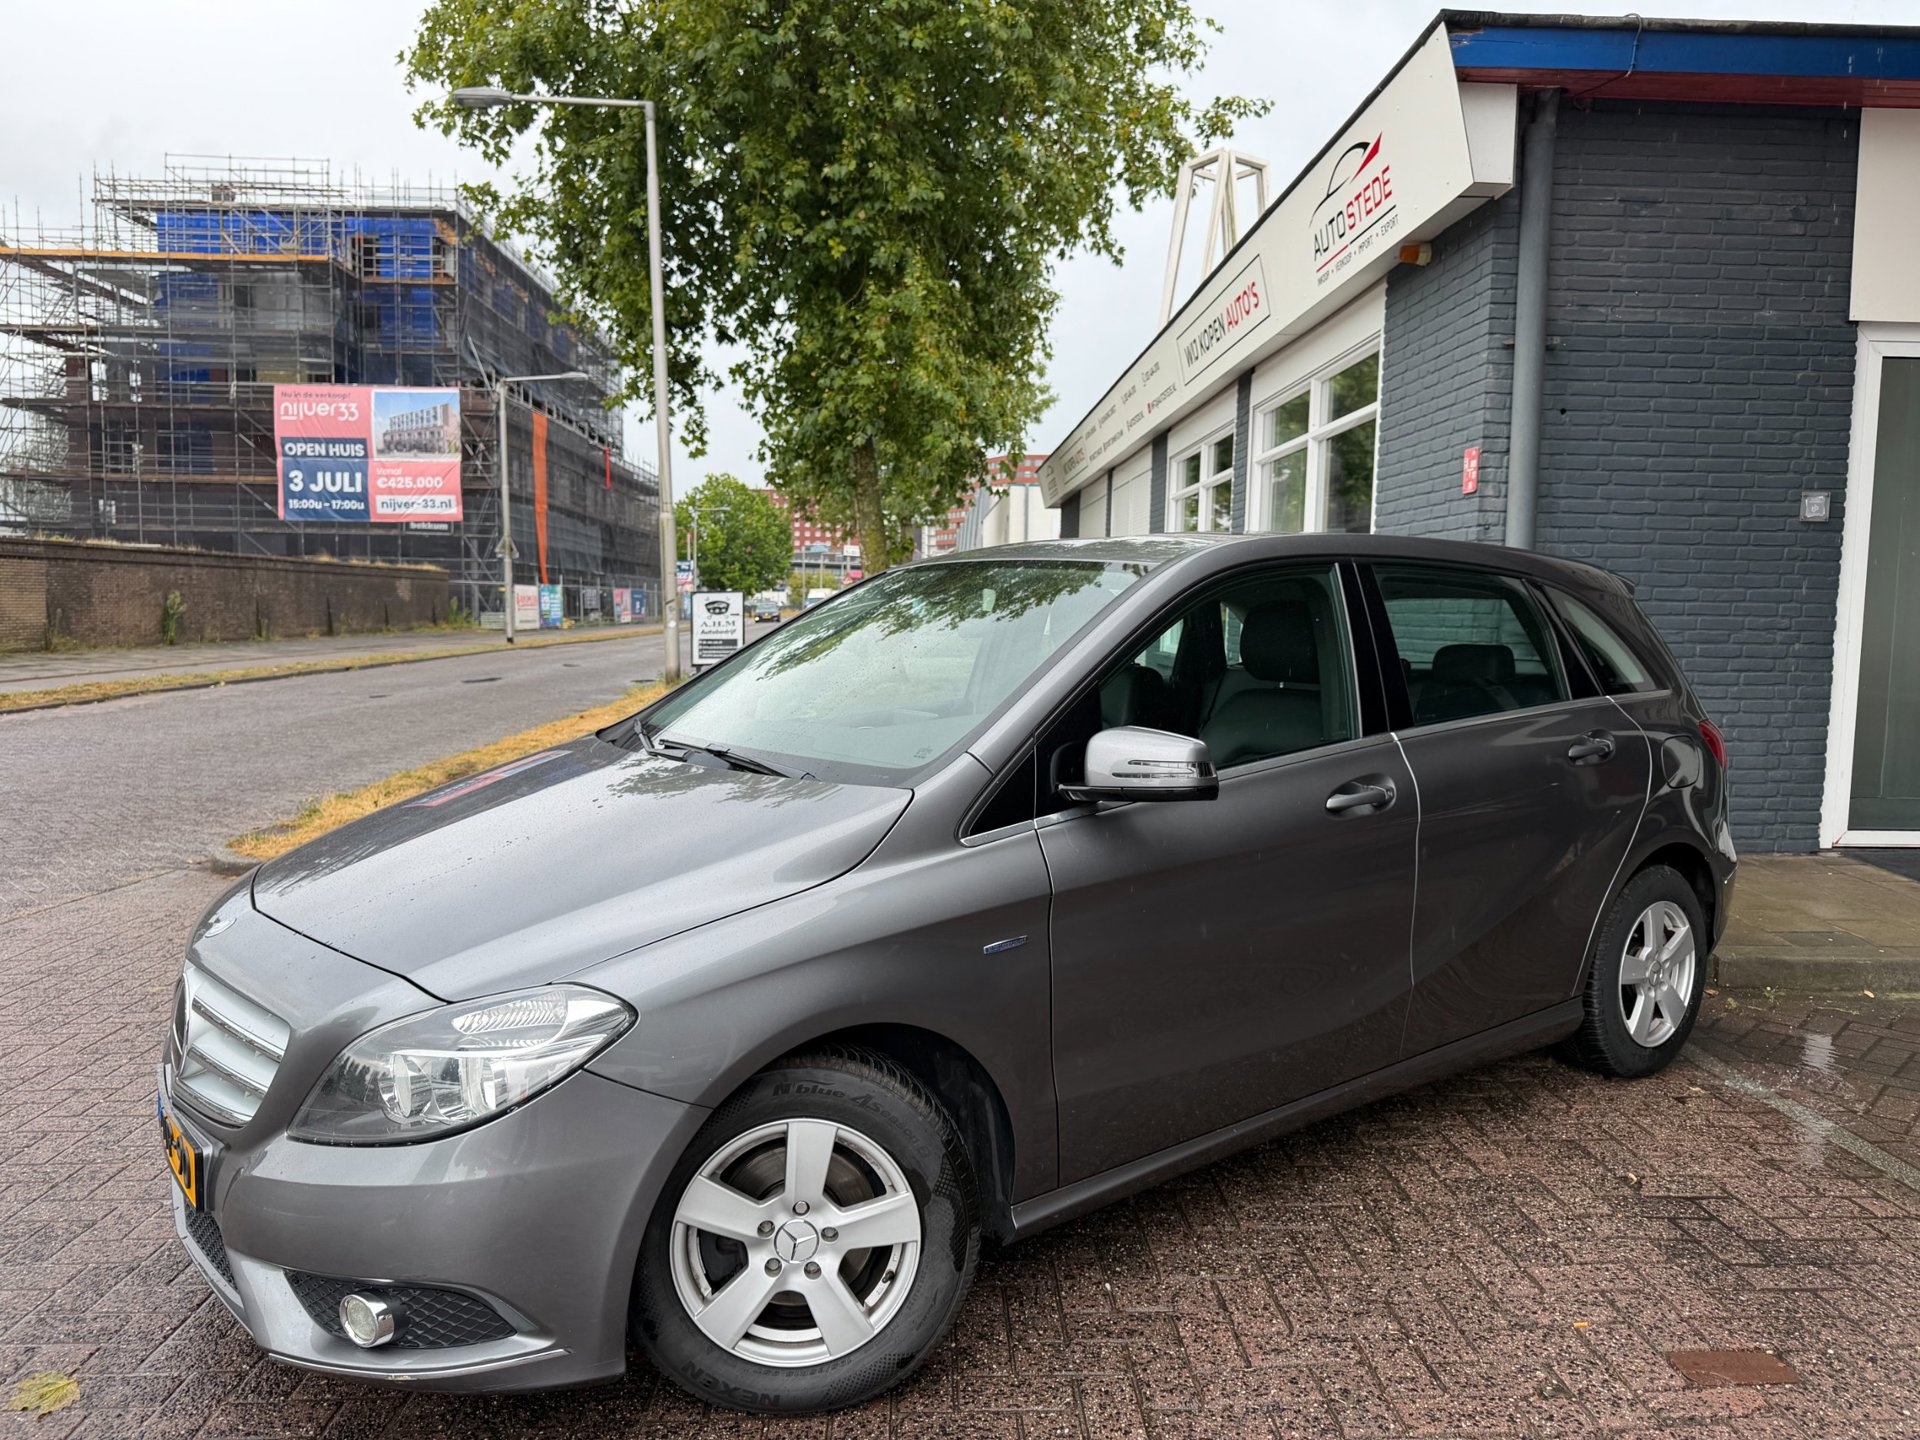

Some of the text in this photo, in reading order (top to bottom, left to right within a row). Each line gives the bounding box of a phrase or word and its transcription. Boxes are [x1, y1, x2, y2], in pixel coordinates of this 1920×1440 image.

[1314, 165, 1393, 262] AUTOSTEDE
[1381, 213, 1399, 237] EXPORT
[1200, 313, 1226, 353] KOPEN
[1225, 281, 1260, 330] AUTO'S
[284, 443, 365, 457] OPEN HUIS
[288, 470, 362, 493] 3 JULI
[376, 477, 443, 488] €425.000
[331, 500, 365, 510] 17:00u
[381, 498, 452, 512] nijver-33.nl
[680, 1361, 780, 1407] NEXEN
